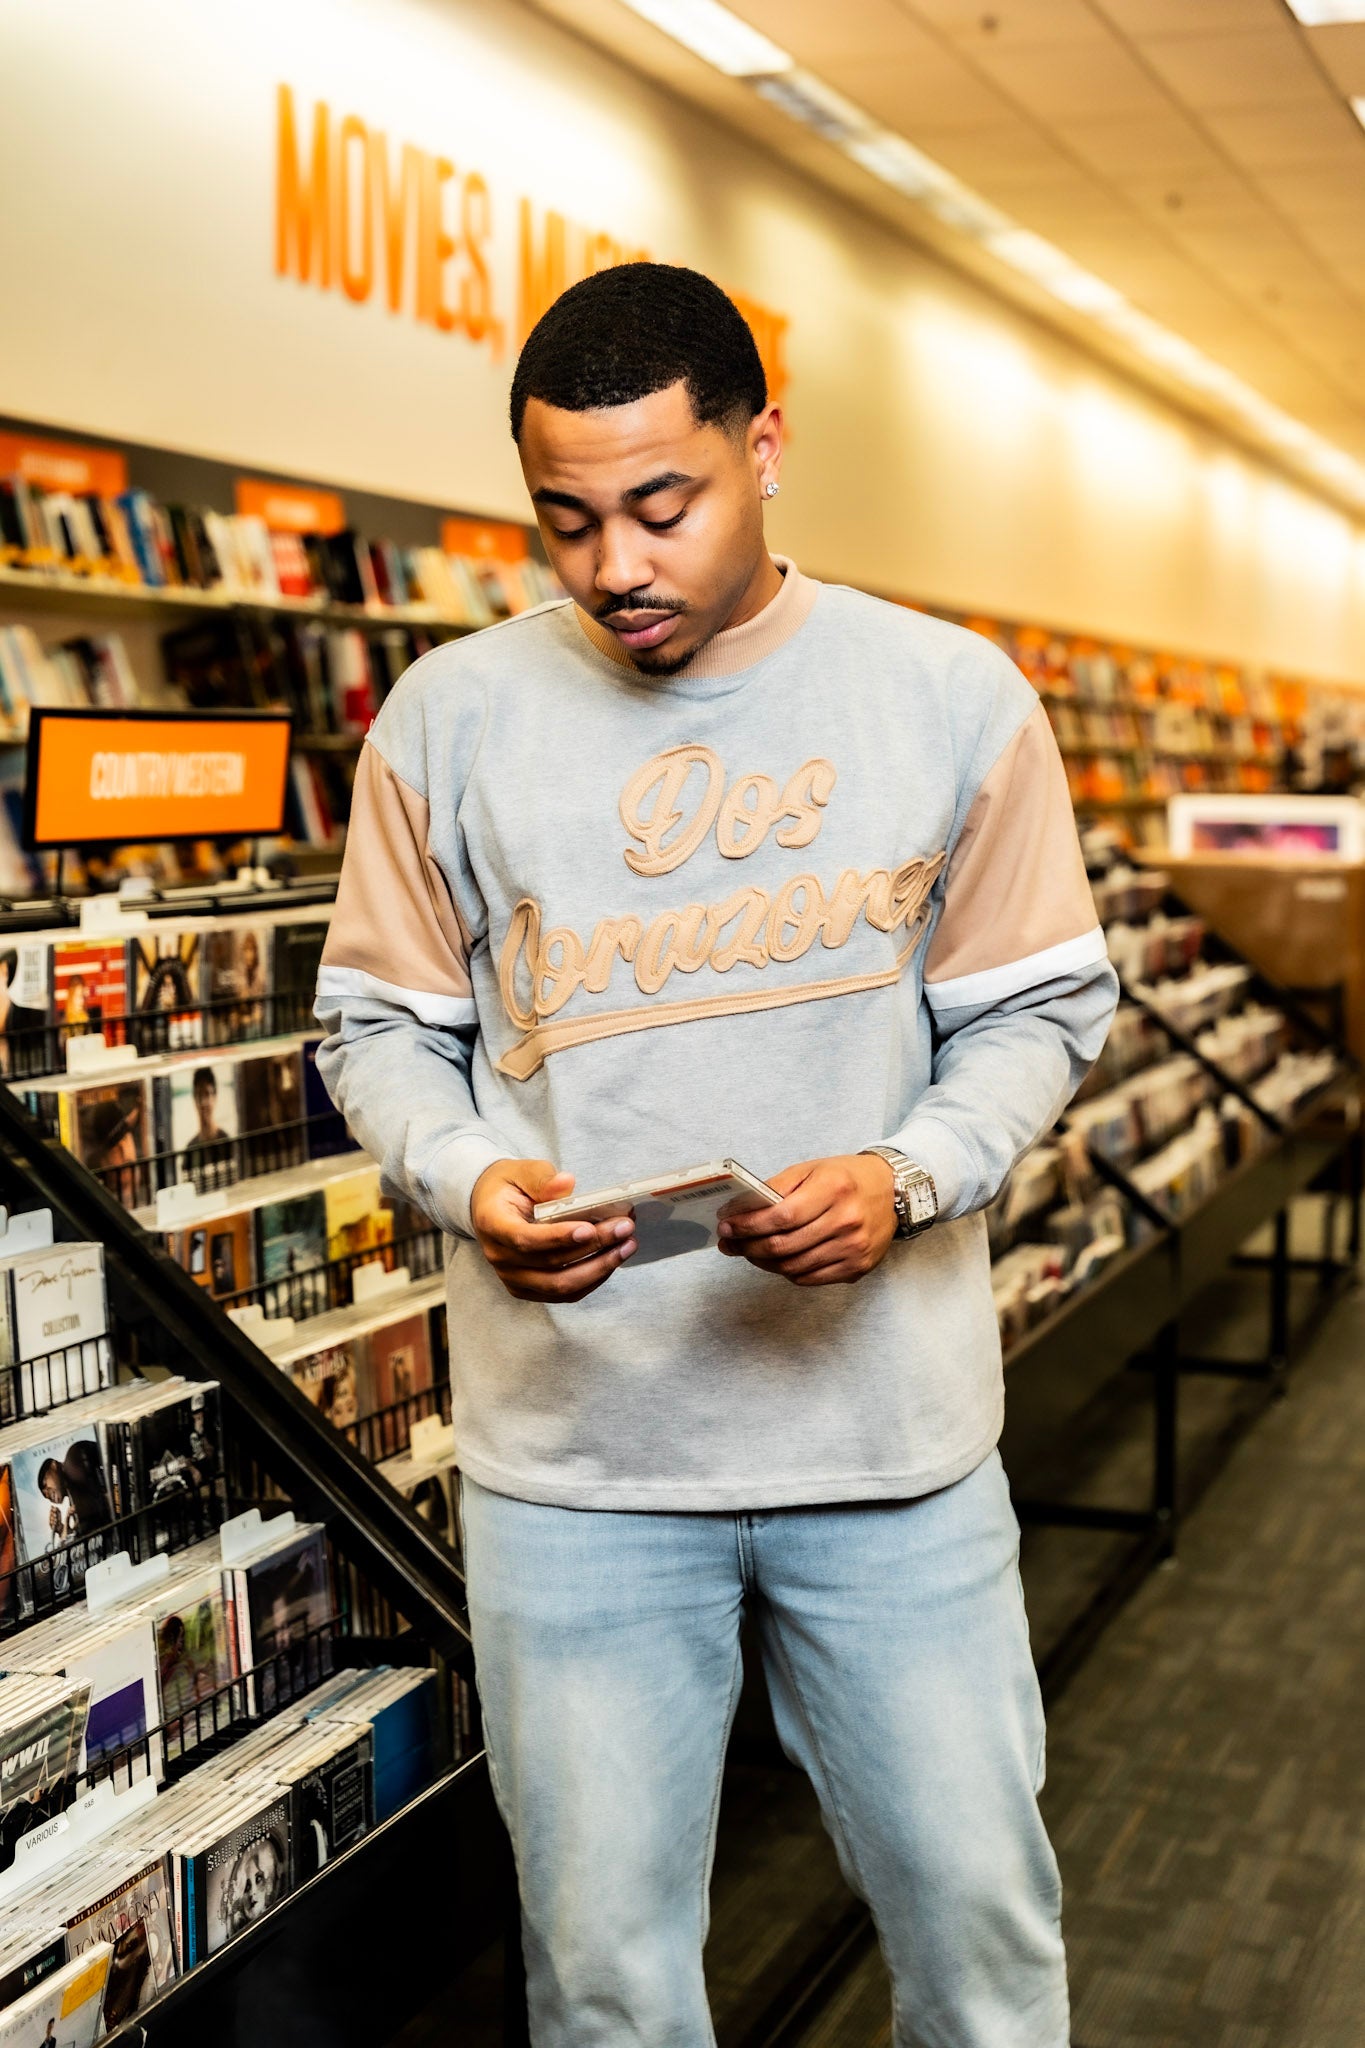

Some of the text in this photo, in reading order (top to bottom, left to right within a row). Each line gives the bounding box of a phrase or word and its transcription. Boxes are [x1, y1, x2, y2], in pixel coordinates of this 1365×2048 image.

[276, 82, 506, 365] MOVIES,
[618, 743, 837, 877] Dos
[1, 1735, 51, 1779] WWII
[25, 1822, 59, 1850] VARIOUS
